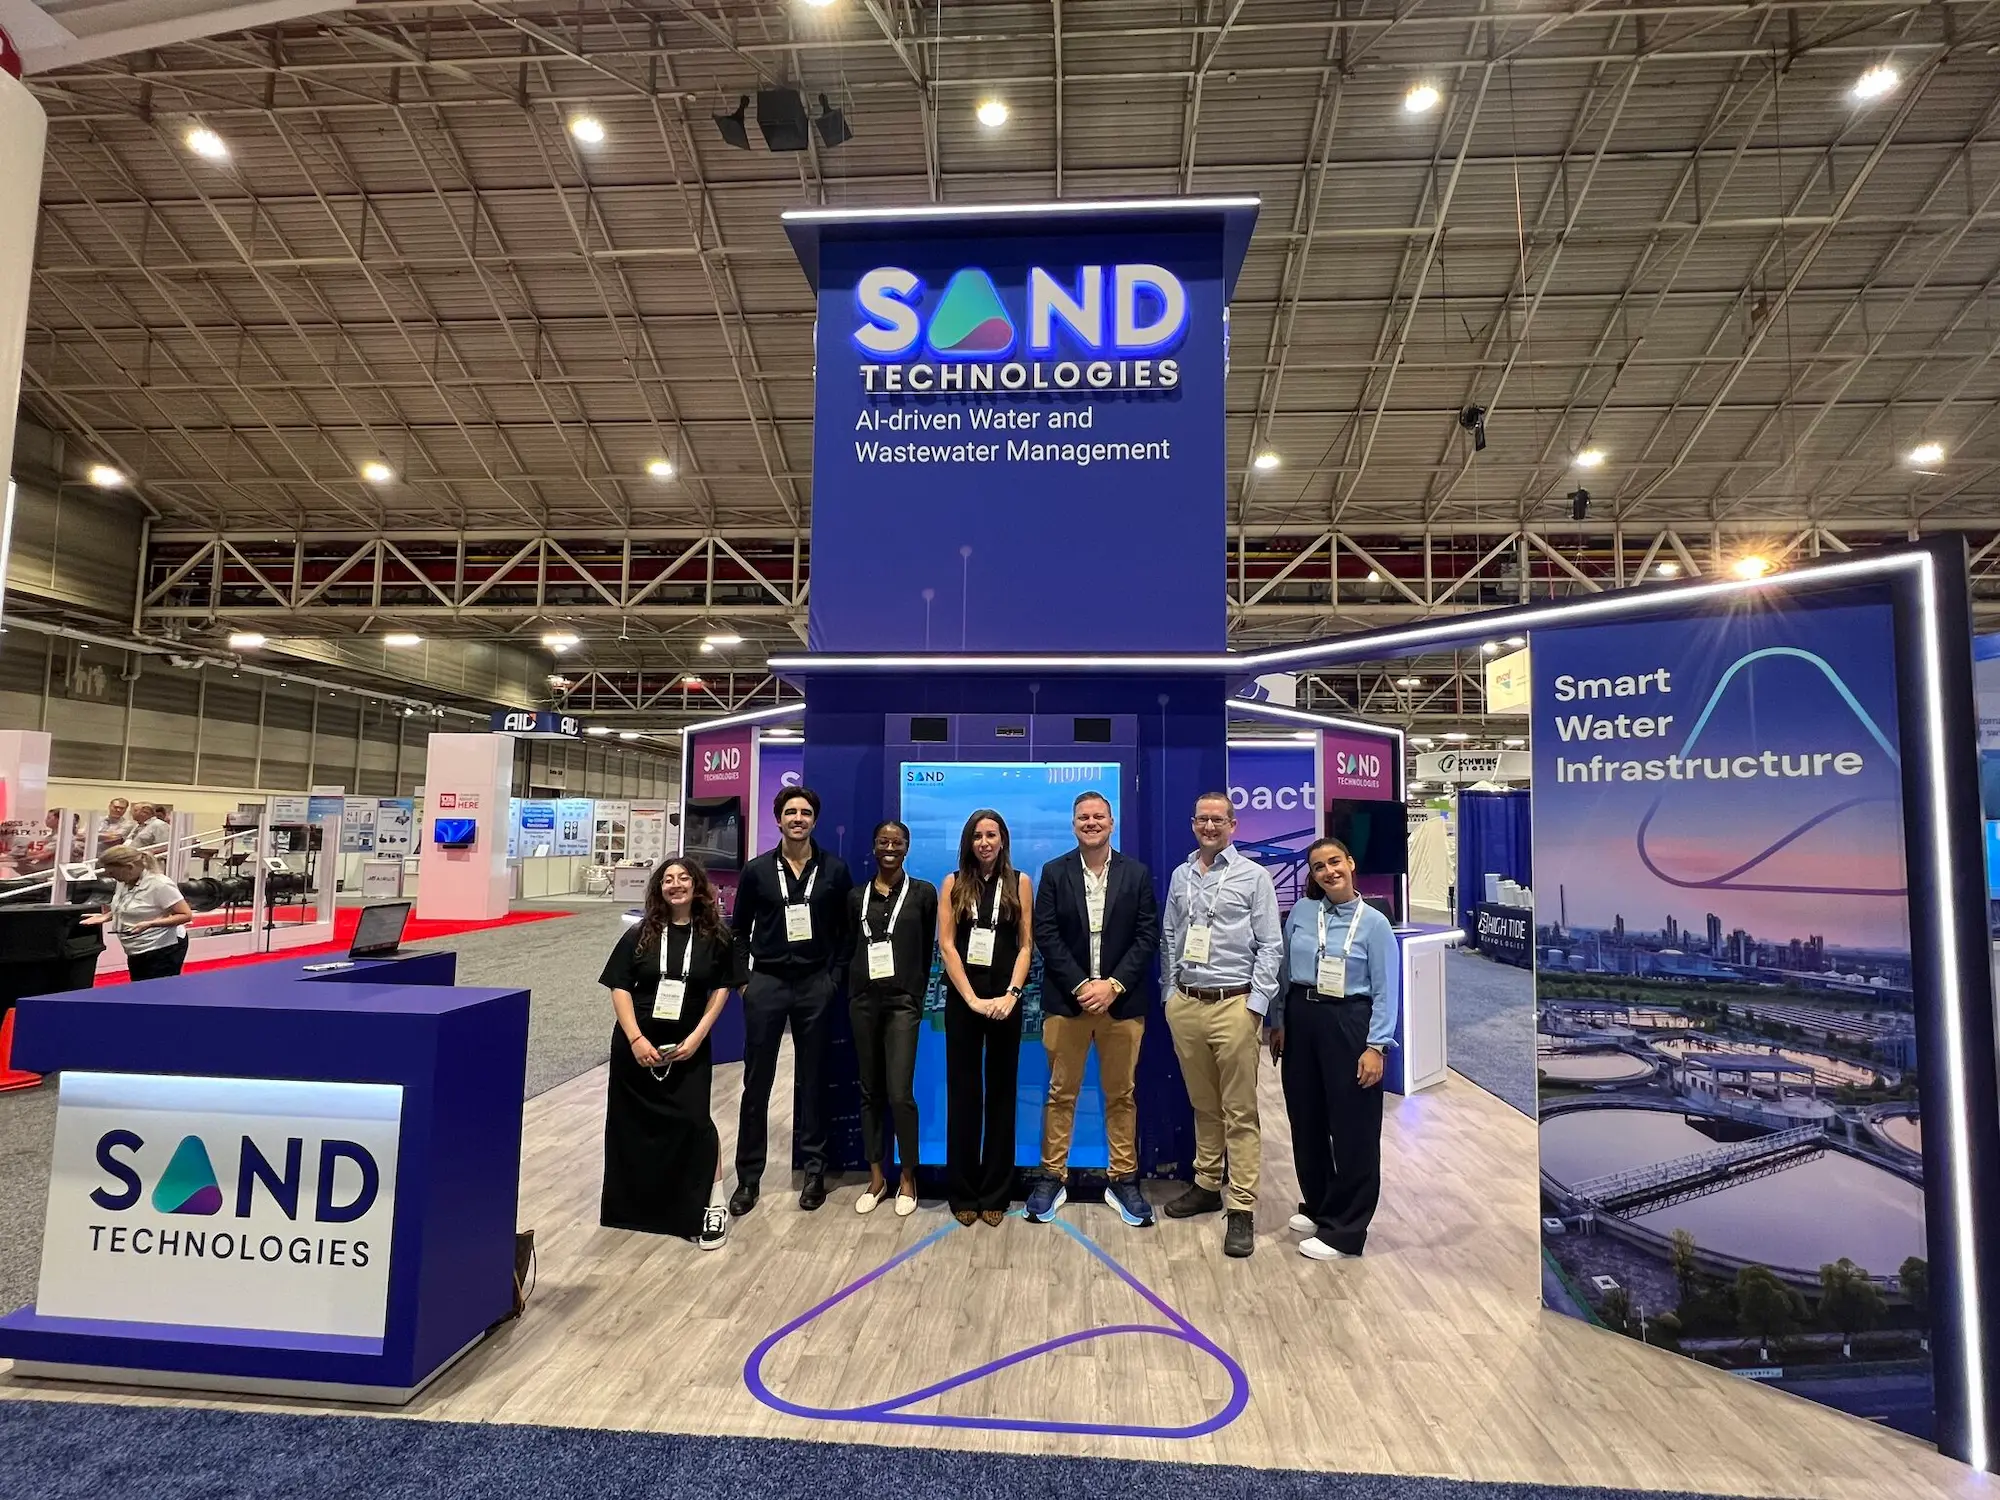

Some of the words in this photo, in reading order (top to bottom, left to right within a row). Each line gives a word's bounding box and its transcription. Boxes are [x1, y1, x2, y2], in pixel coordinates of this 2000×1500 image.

[853, 264, 1186, 352] SAND
[860, 359, 1179, 391] TECHNOLOGIES
[855, 409, 961, 431] AI-driven
[969, 408, 1041, 430] Water
[1048, 406, 1093, 429] and
[855, 441, 999, 462] Wastewater
[1006, 438, 1170, 467] Management
[1554, 668, 1672, 701] Smart
[504, 713, 537, 731] AID
[1555, 713, 1673, 742] Water
[703, 748, 741, 772] SAND
[1336, 751, 1381, 778] SAND
[1458, 758, 1498, 767] SCHWING
[1556, 750, 1863, 783] Infrastructure
[704, 772, 740, 782] TECHNOLOGIES
[907, 771, 945, 782] SAND
[1337, 777, 1380, 788] TECHNOLOGIES
[458, 801, 480, 809] HERE
[1488, 915, 1508, 937] HIGH
[1508, 919, 1527, 940] TIDE
[89, 1129, 380, 1223] SAND
[89, 1225, 369, 1268] TECHNOLOGIES
